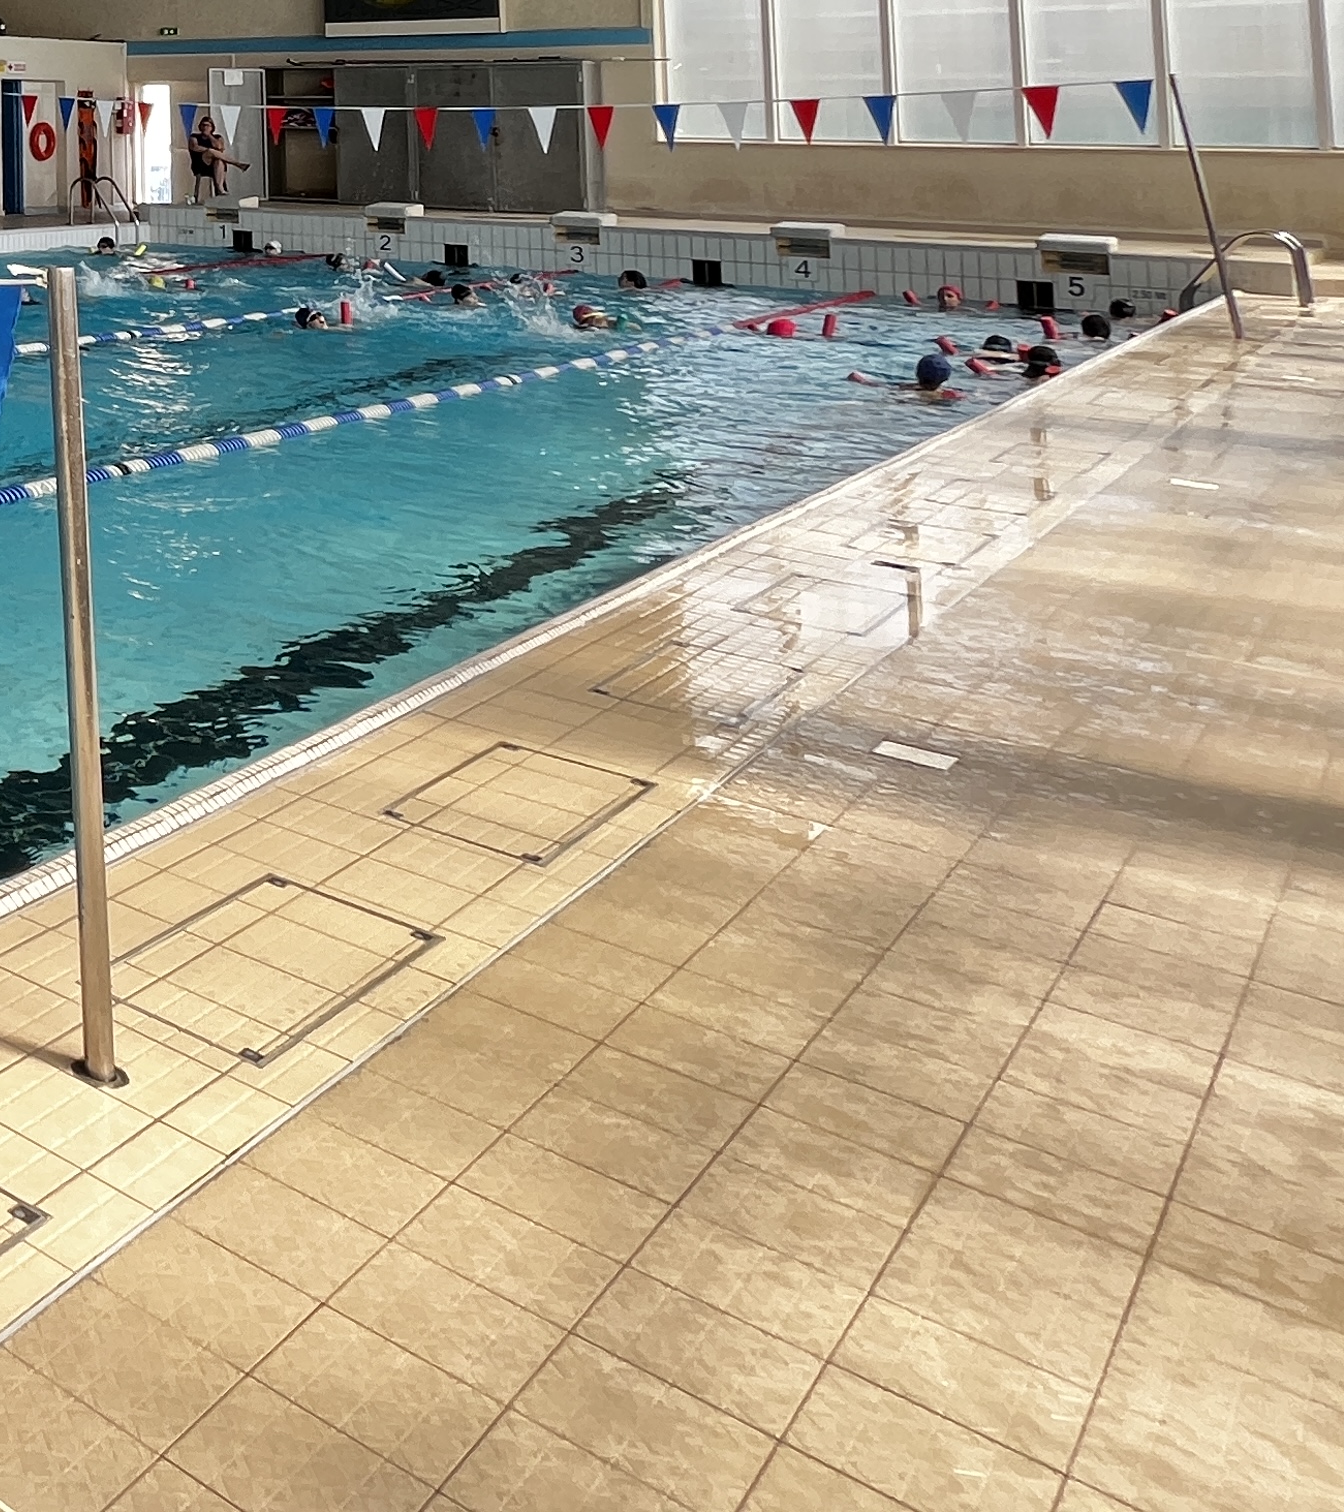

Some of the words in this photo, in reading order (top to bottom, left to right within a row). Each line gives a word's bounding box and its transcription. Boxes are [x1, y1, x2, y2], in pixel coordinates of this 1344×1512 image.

[219, 225, 226, 239] 1
[379, 234, 392, 251] 2
[570, 246, 584, 263] 3
[794, 260, 811, 278] 4
[1068, 276, 1085, 297] 5
